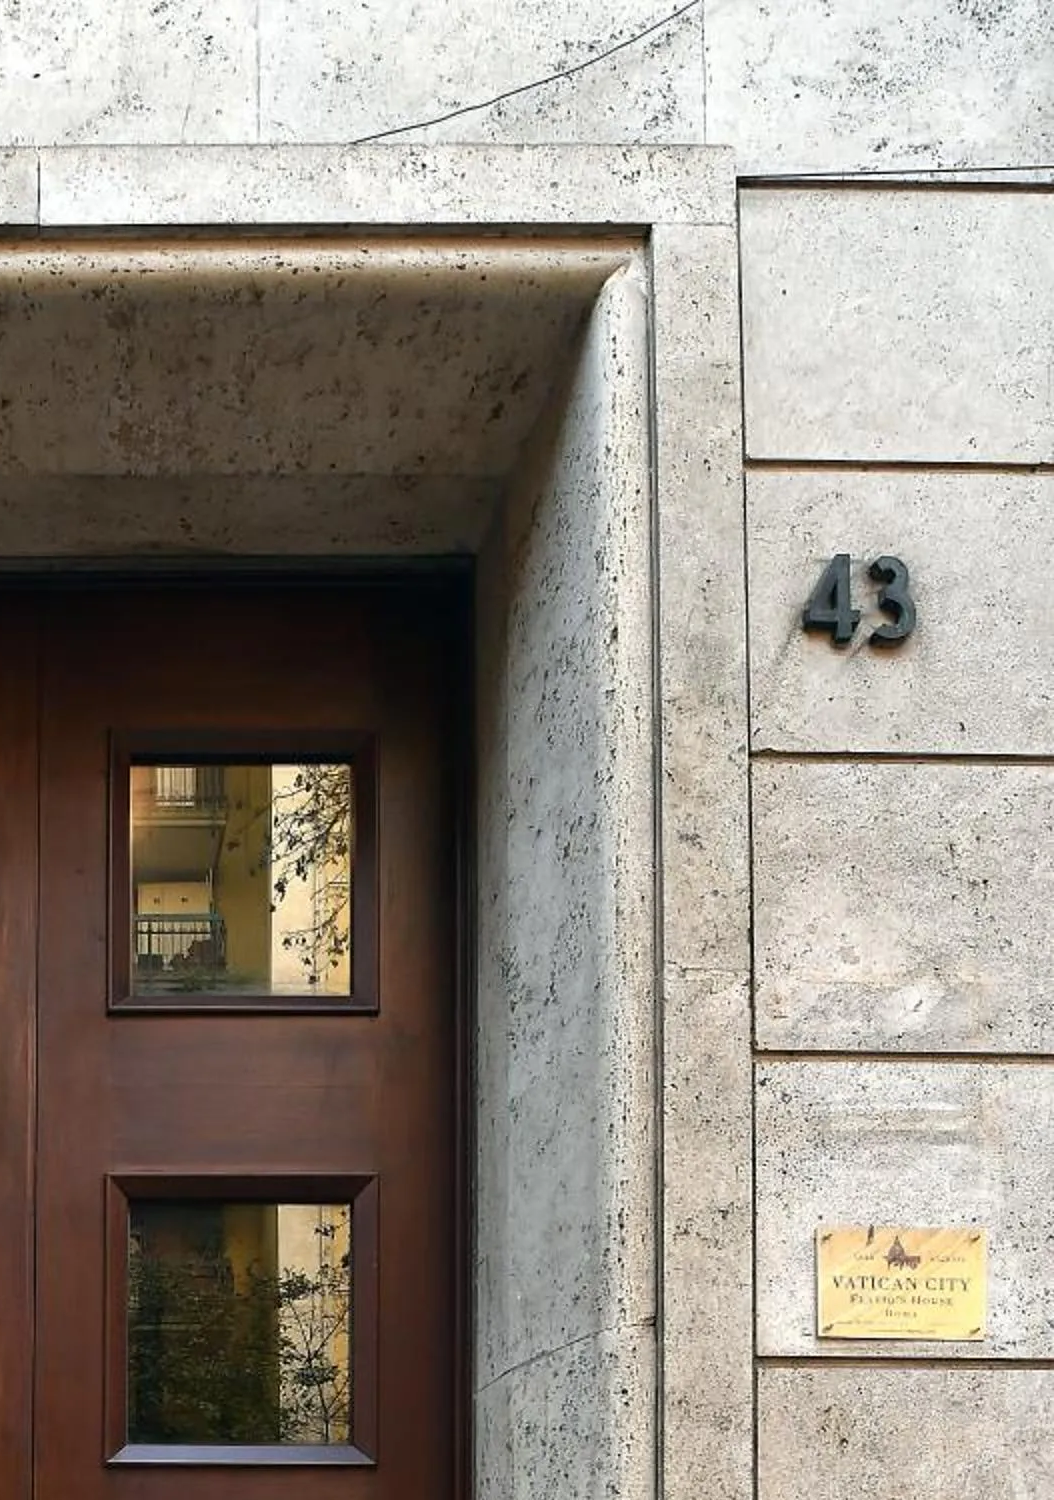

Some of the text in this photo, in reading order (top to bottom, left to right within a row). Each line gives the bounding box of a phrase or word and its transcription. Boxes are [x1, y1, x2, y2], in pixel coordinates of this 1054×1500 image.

[803, 554, 916, 645] 43
[833, 1275, 970, 1292] VATICAN CITY
